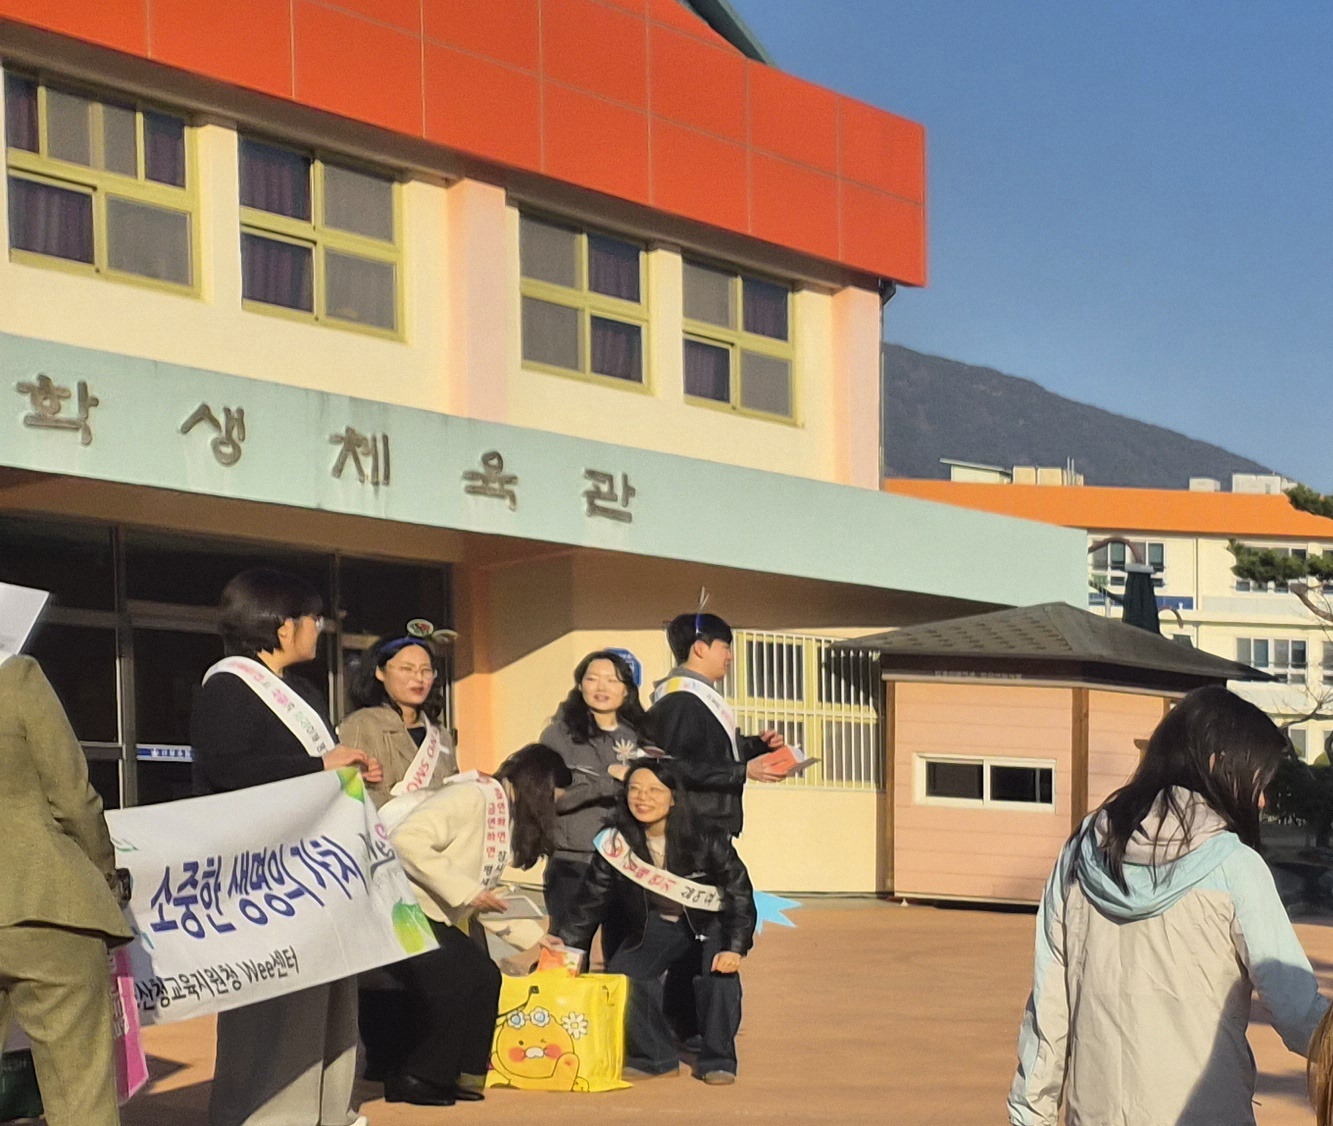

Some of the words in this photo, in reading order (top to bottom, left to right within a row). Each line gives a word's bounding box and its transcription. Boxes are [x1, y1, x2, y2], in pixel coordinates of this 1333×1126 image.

[16, 374, 637, 524] 학생체육관
[150, 857, 236, 939] 소중한
[228, 843, 325, 927] 생명의
[290, 835, 370, 900] 가치
[136, 965, 243, 1011] 산청교육지원청
[243, 945, 300, 982] Wee센터
